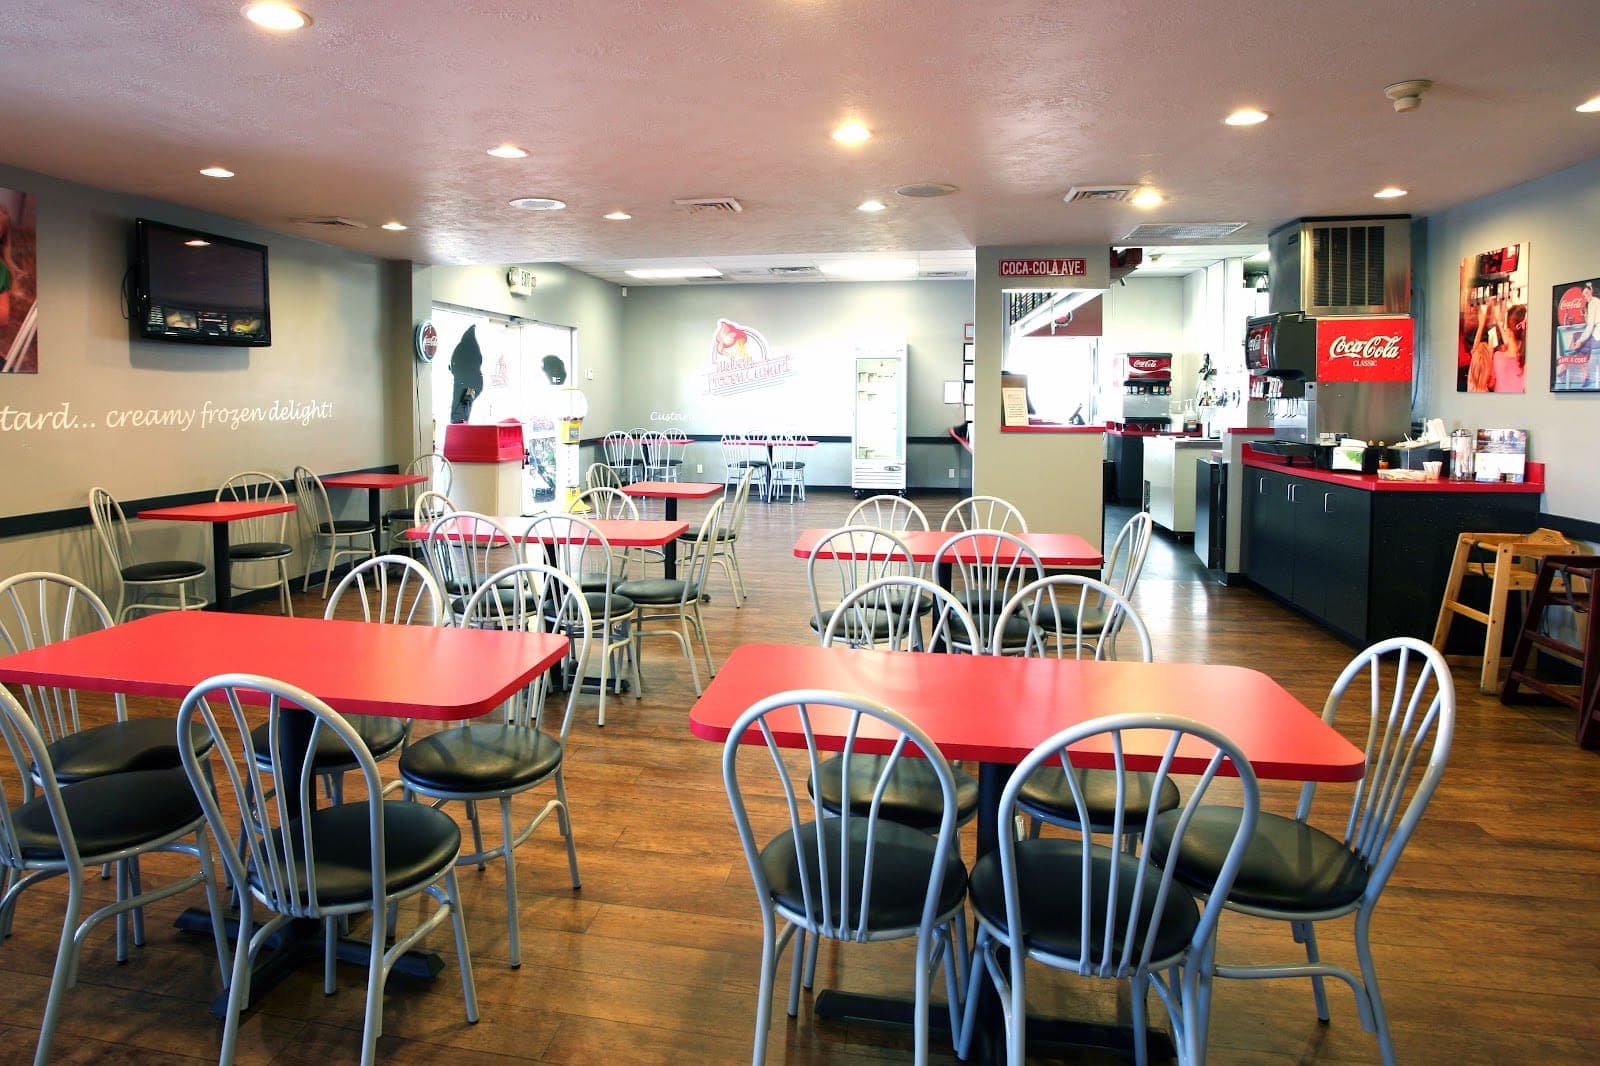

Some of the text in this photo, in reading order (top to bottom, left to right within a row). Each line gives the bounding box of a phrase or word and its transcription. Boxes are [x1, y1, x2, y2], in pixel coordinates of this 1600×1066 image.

[1002, 260, 1084, 276] COCA-COLA AVE.
[1329, 335, 1402, 361] Coca-Cola
[1133, 359, 1158, 368] Coca-Cola
[106, 408, 196, 432] creamy
[200, 400, 267, 430] frozen
[268, 399, 333, 426] delight!
